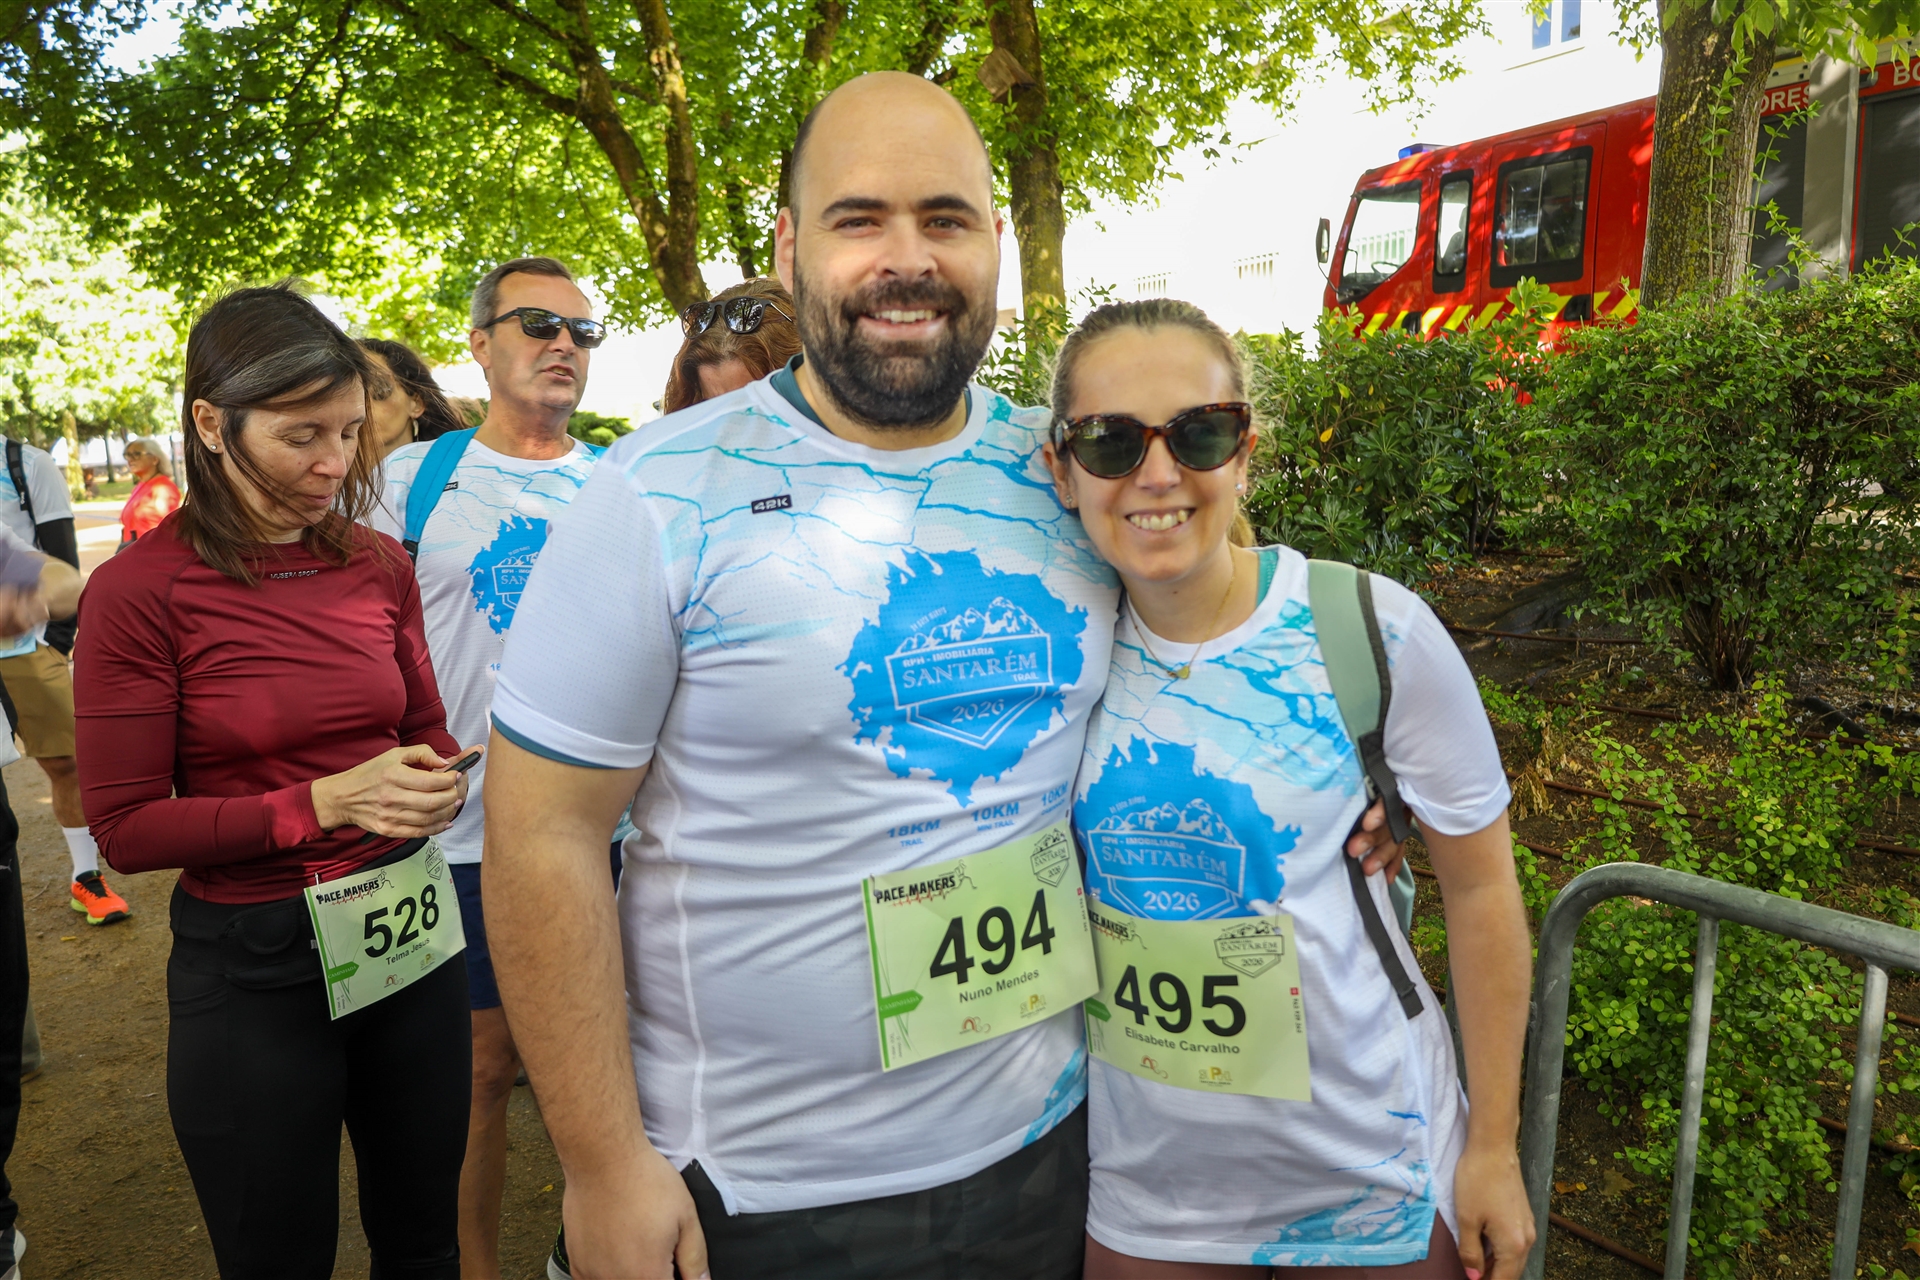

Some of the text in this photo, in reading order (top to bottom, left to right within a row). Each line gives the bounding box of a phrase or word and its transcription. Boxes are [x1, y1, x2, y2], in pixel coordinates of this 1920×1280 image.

[298, 569, 318, 577] SPORT
[902, 656, 925, 668] RPH
[932, 647, 995, 662] IMOBILIÁRIA
[902, 650, 1038, 689] SANTARÉM
[1012, 671, 1040, 682] TRAIL
[951, 699, 1005, 724] 2026
[970, 801, 1020, 822] 10KM
[886, 818, 941, 838] 18KM
[977, 819, 1015, 832] MINI TRAIL
[900, 837, 924, 848] TRAIL
[1101, 835, 1119, 845] RPH
[1101, 845, 1228, 877] SANTARÉM
[1143, 890, 1201, 912] 2026
[364, 884, 440, 958] 528
[929, 888, 1056, 985] 494
[385, 949, 410, 966] Telma
[410, 937, 430, 953] Jesus
[959, 968, 1040, 1004] Nuno Mendes
[1114, 964, 1247, 1037] 495
[1125, 1026, 1240, 1054] Elisabete Carvalho
